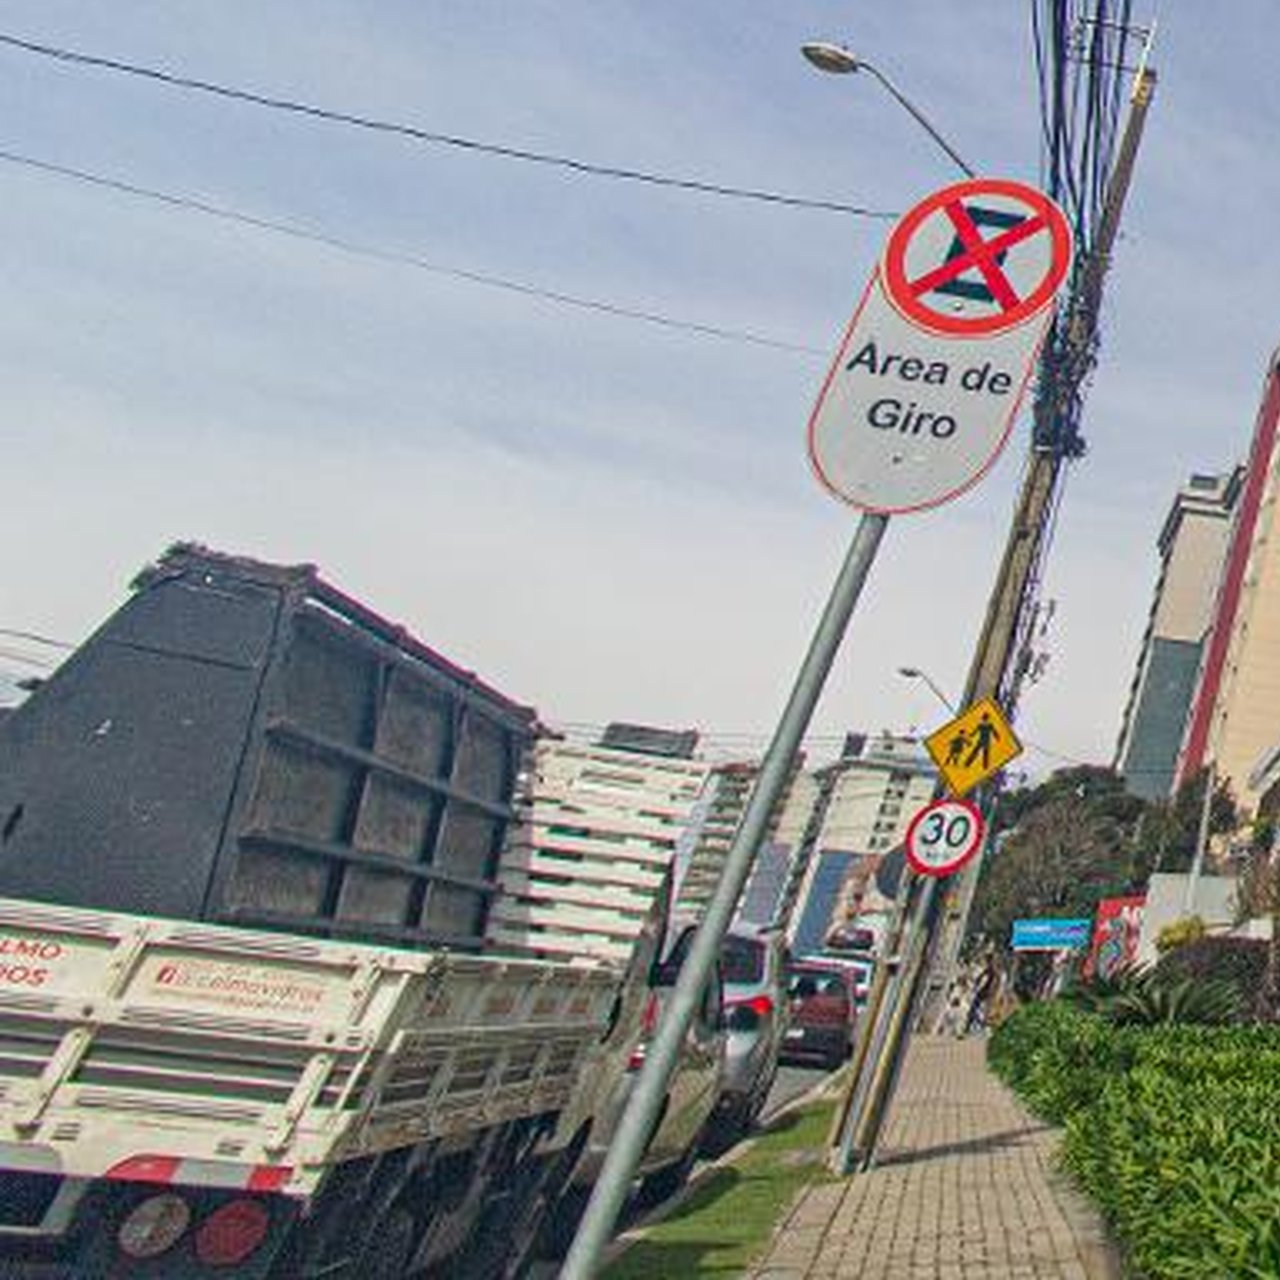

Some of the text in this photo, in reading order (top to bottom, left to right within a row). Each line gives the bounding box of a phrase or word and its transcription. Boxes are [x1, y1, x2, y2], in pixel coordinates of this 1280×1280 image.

[960, 361, 1013, 396] de
[867, 398, 957, 438] Giro
[920, 812, 971, 848] 30
